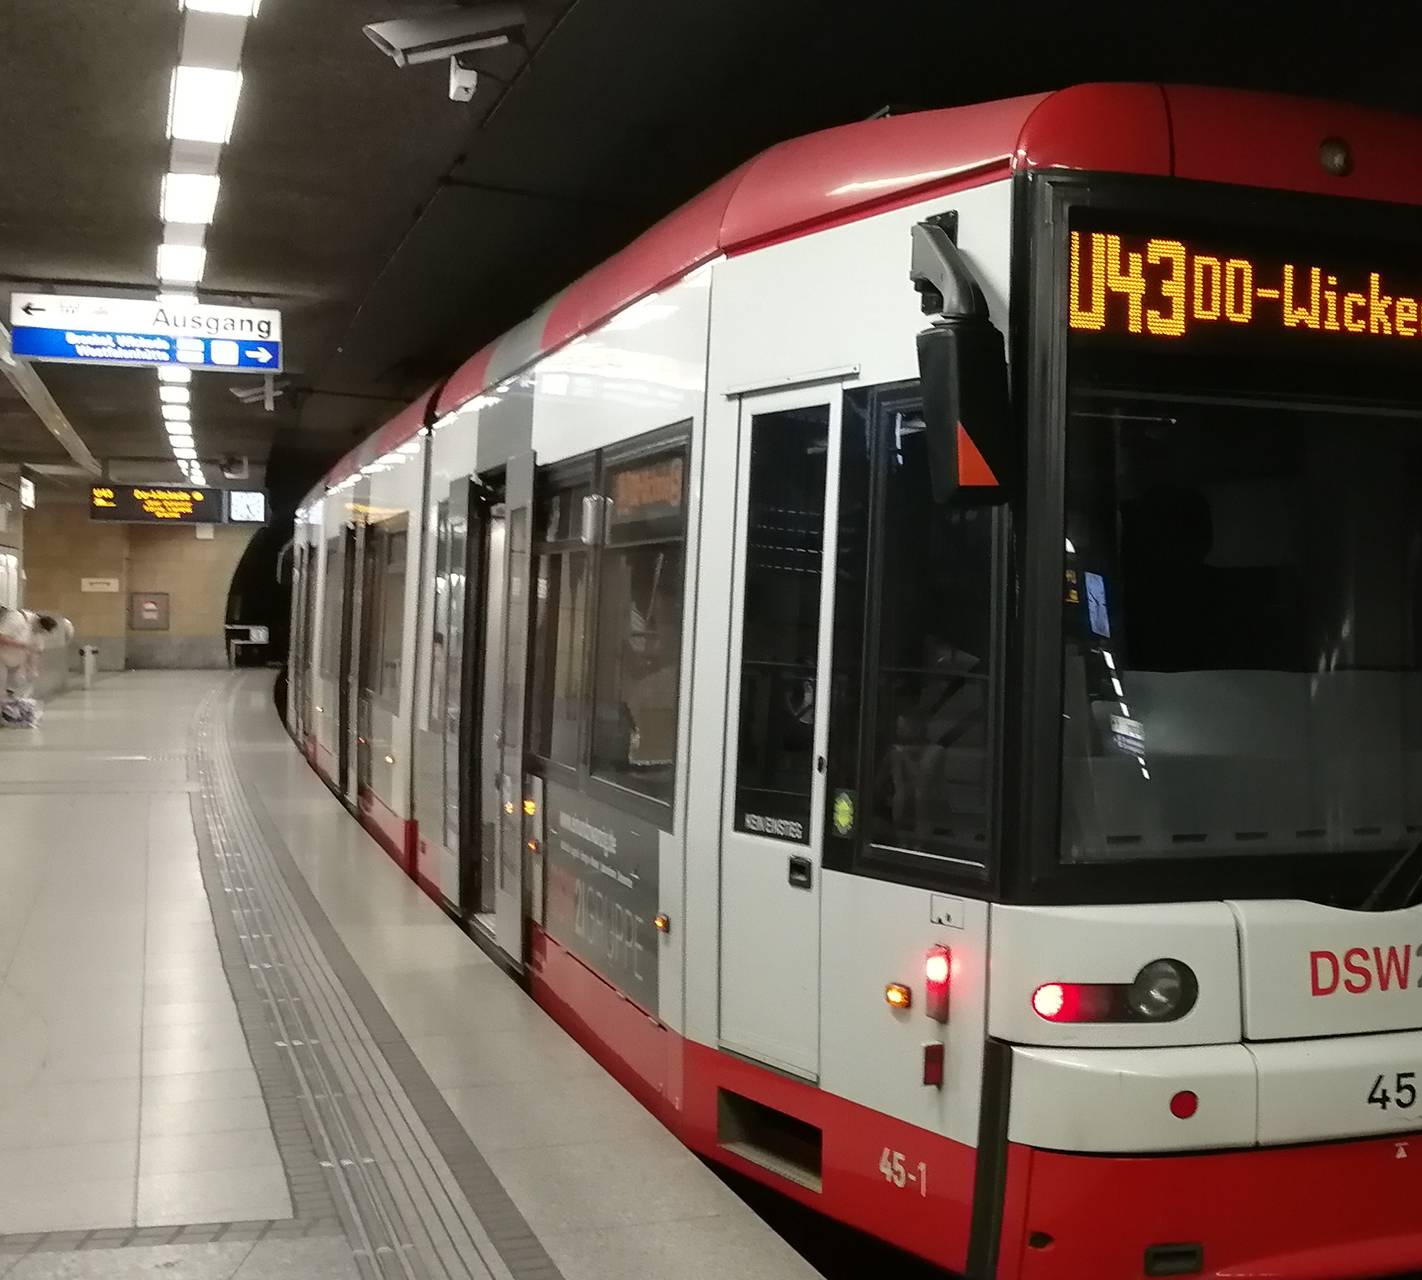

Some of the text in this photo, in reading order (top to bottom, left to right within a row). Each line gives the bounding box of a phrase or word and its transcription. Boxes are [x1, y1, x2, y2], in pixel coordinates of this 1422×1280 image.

[1069, 231, 1186, 336] U43
[152, 308, 272, 338] Ausgang
[1367, 1072, 1416, 1110] 45
[879, 1147, 927, 1198] 45-1
